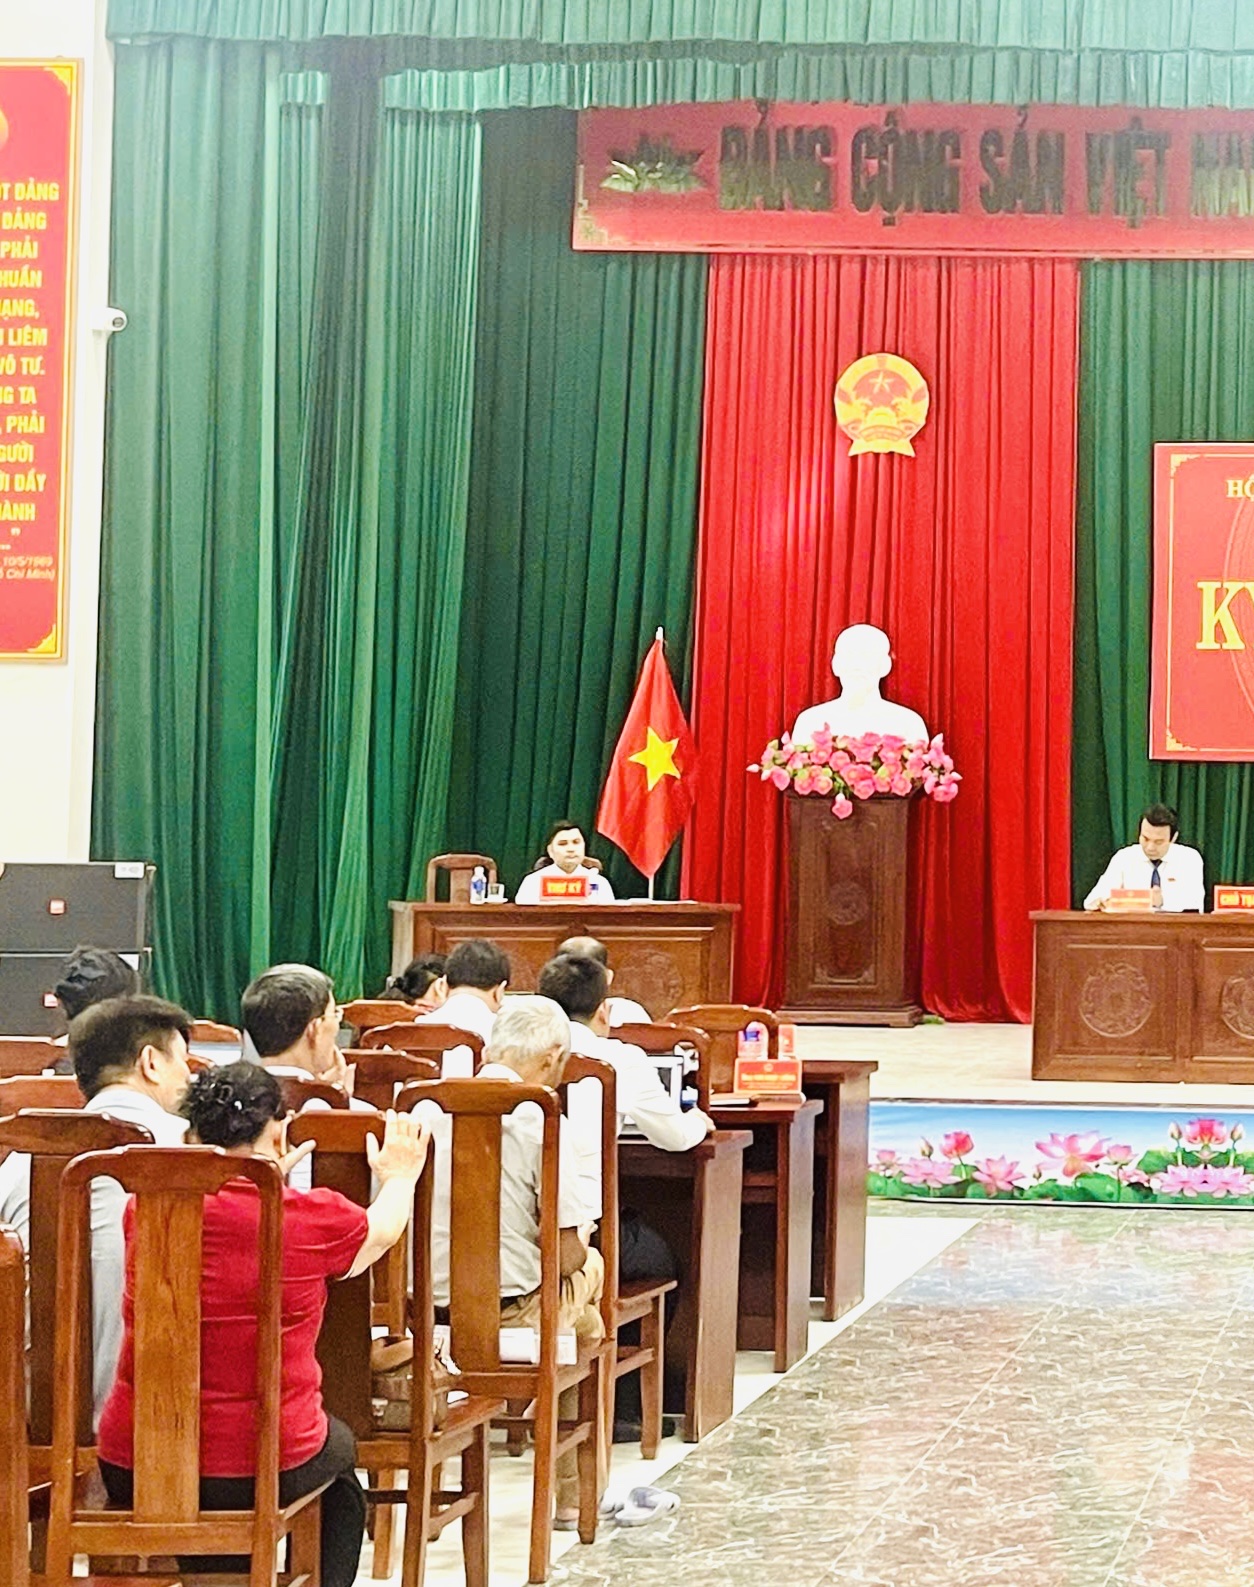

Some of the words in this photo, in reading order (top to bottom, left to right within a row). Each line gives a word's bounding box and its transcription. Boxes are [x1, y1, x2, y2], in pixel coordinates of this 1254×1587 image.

[852, 110, 961, 226] CỘNG
[980, 104, 1065, 214] SẢN
[1085, 115, 1171, 228] VIỆT
[0, 235, 39, 259] PHẢI
[8, 324, 48, 346] LIÊM
[18, 386, 38, 405] TA
[6, 409, 45, 434] PHẢI
